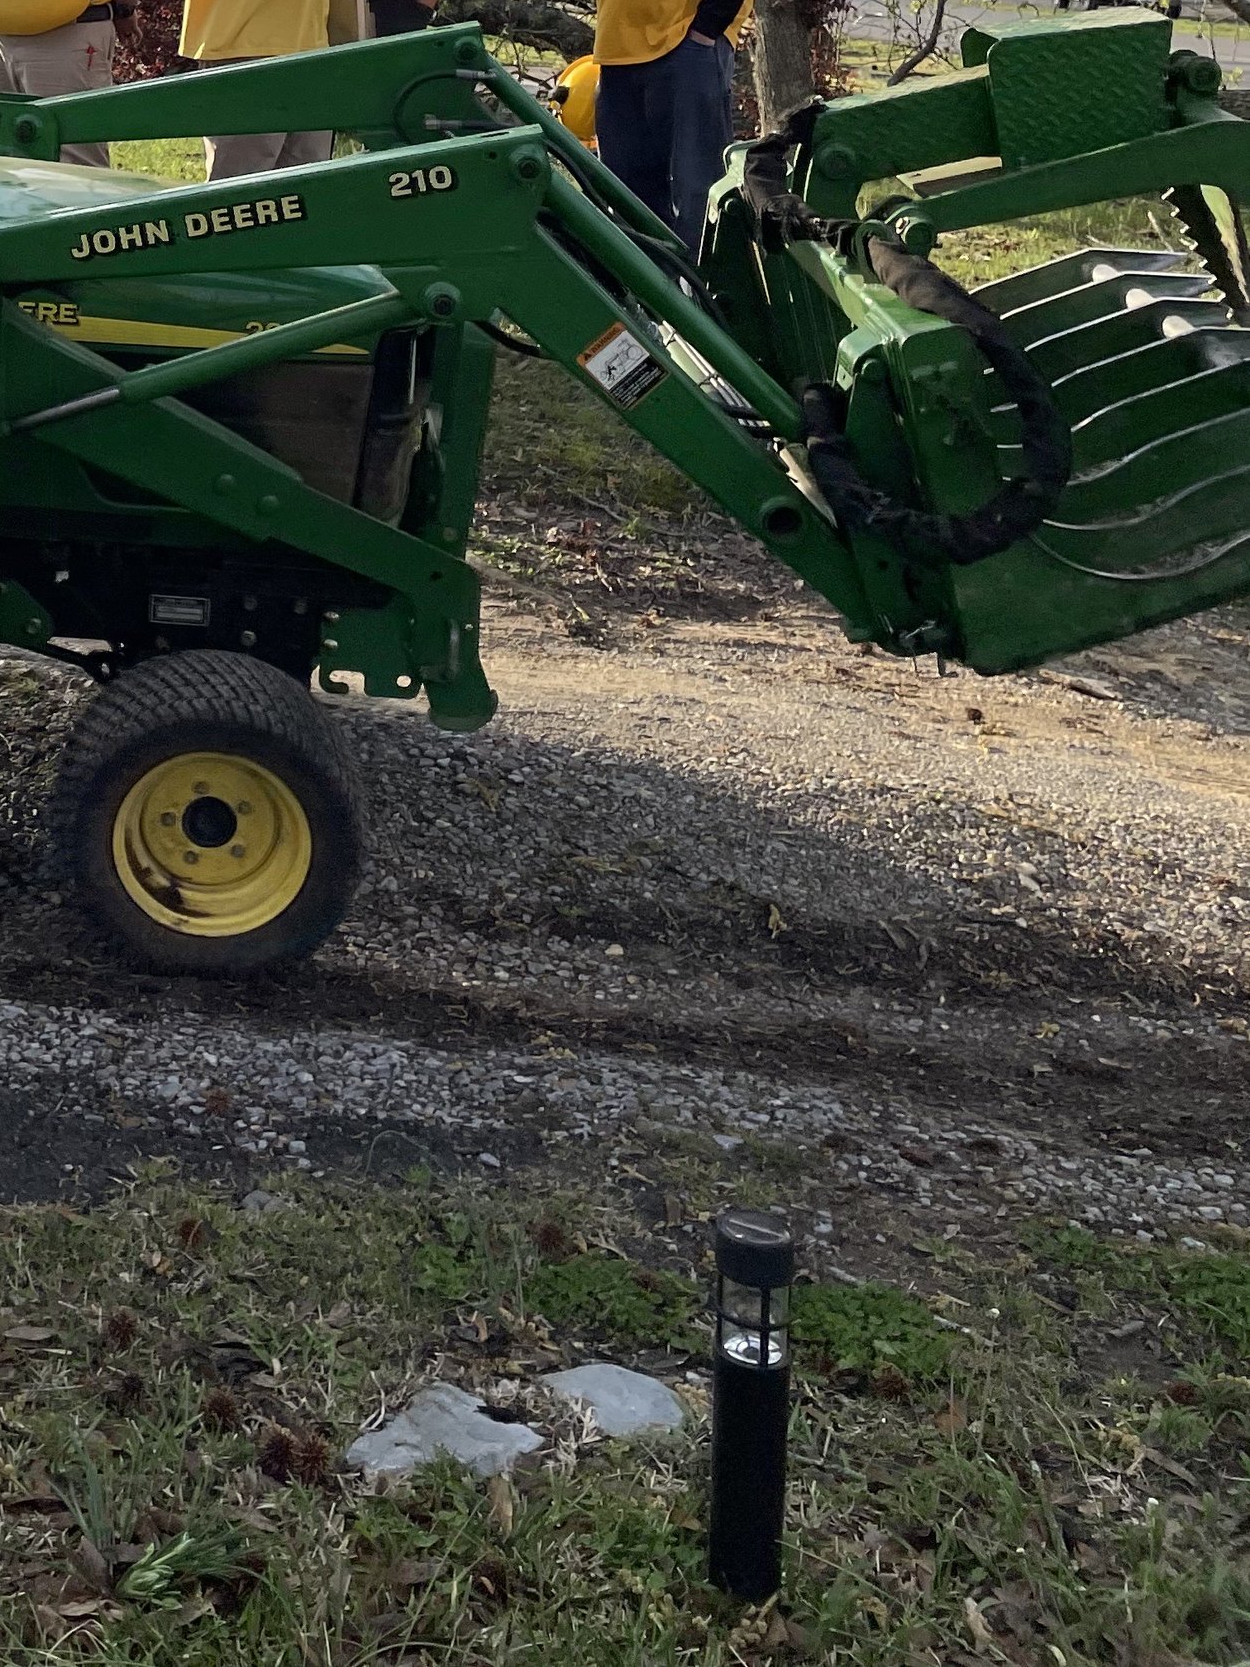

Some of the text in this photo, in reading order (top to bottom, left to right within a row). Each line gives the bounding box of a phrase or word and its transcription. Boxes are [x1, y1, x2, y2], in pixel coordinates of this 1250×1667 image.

[388, 165, 453, 197] 210
[70, 194, 303, 259] JOHN DEERE
